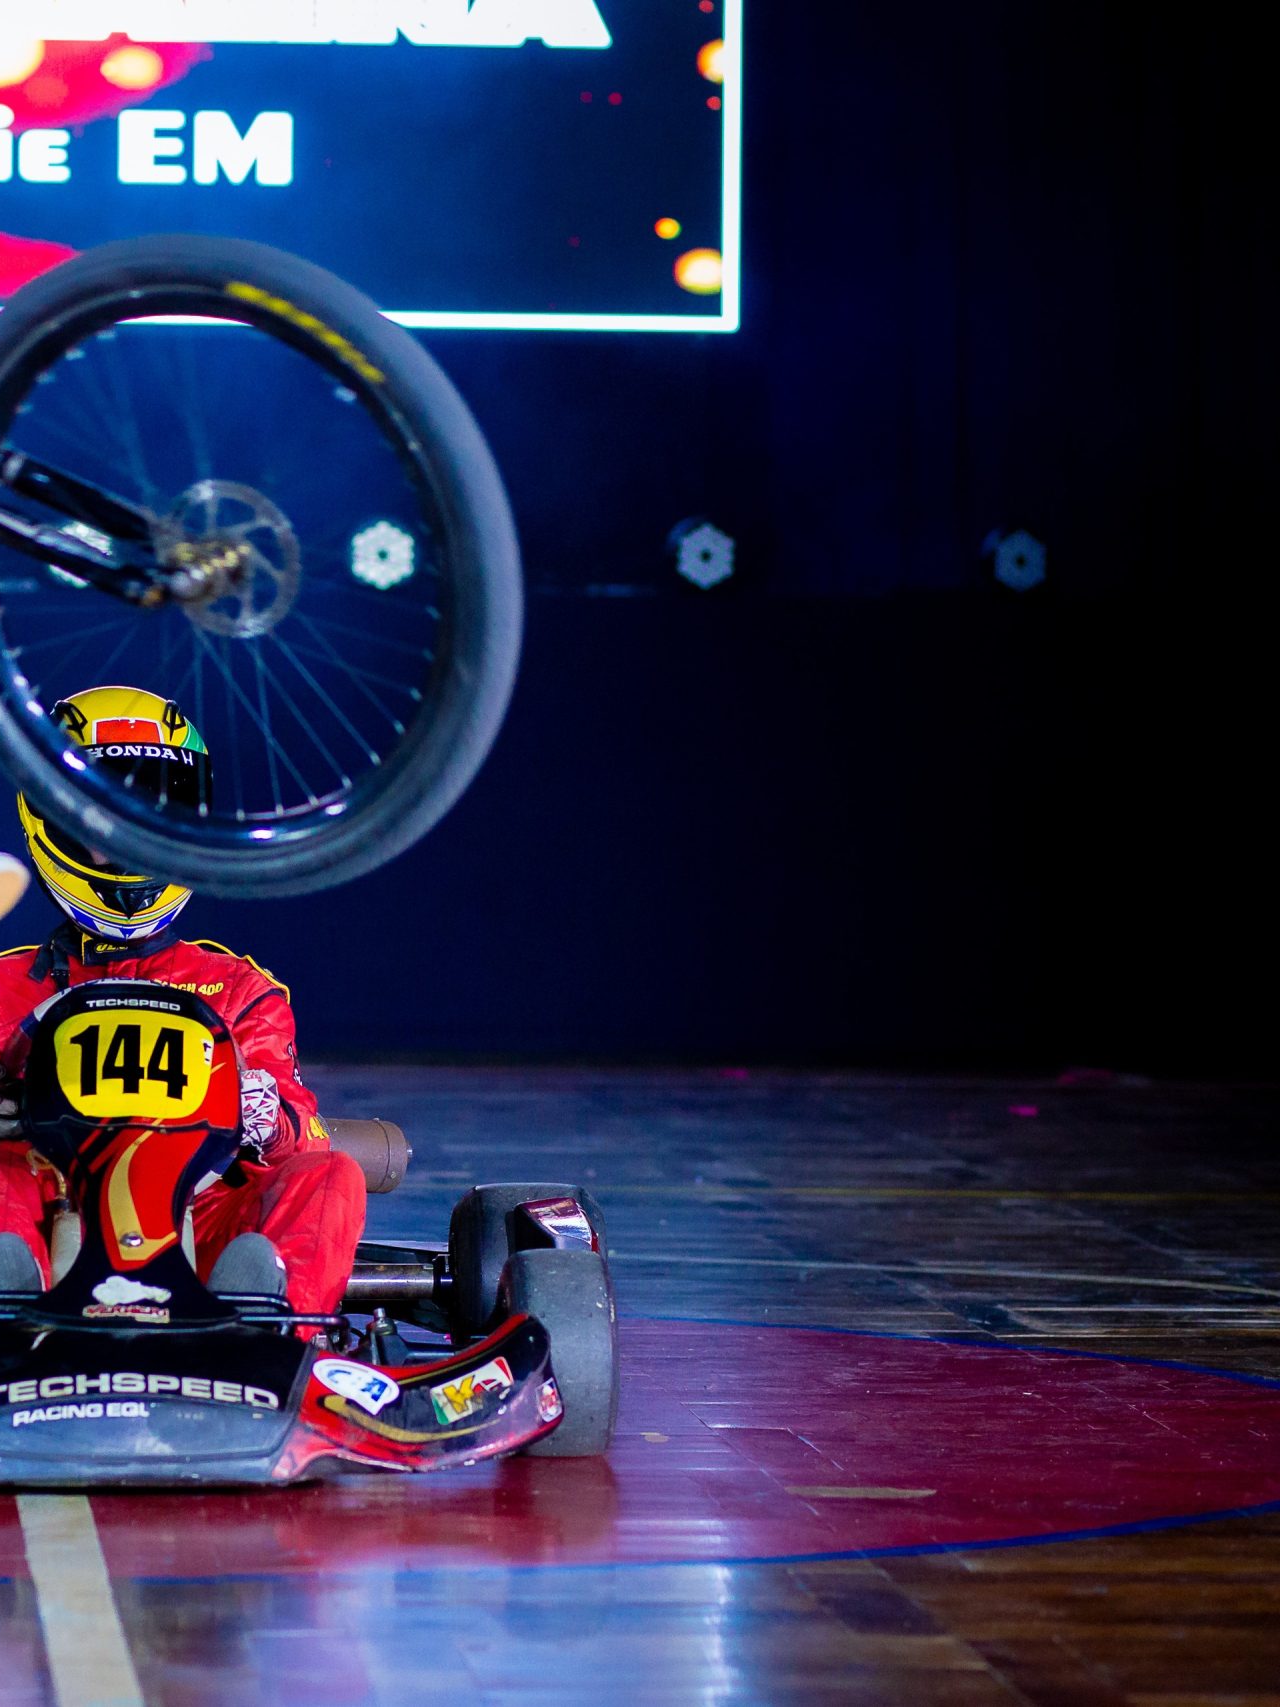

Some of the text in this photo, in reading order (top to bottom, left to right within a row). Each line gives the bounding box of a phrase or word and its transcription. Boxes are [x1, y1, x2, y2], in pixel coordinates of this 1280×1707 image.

[116, 108, 294, 186] EM
[85, 745, 179, 761] HONDA
[86, 998, 181, 1012] TECHSPEED
[70, 1024, 188, 1101] 144
[12, 1404, 104, 1427] RACING
